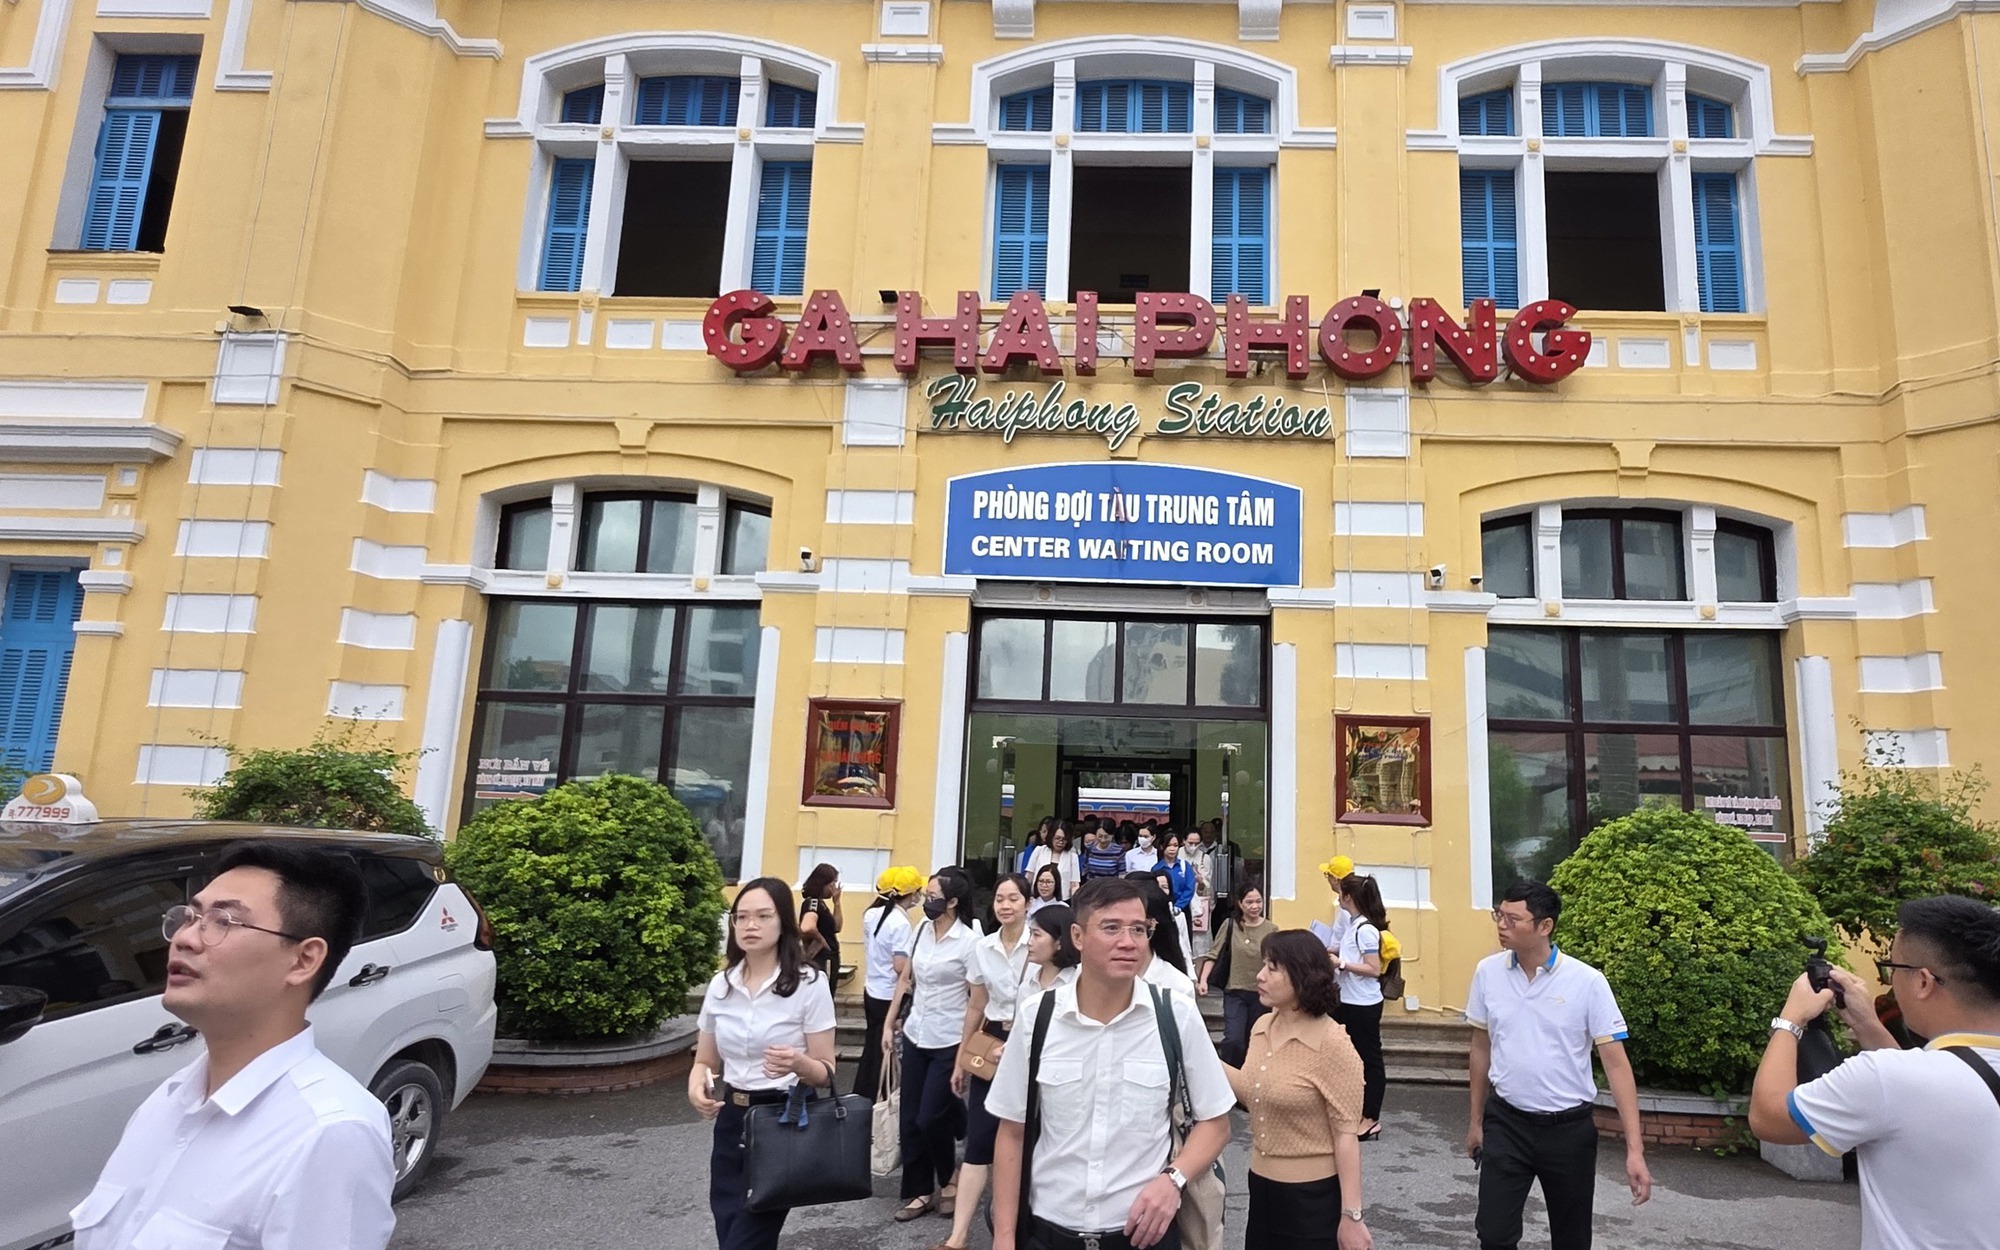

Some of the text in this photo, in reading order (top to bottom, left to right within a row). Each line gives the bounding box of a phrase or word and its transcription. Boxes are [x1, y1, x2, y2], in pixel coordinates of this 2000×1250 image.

[702, 289, 1592, 384] GA HAI PHONG
[926, 374, 1334, 451] Haiphong Station
[973, 484, 1275, 528] PHÒNG ĐỢI TÀU TRUNG TÂM
[971, 535, 1274, 565] CENTER WAITING ROOM
